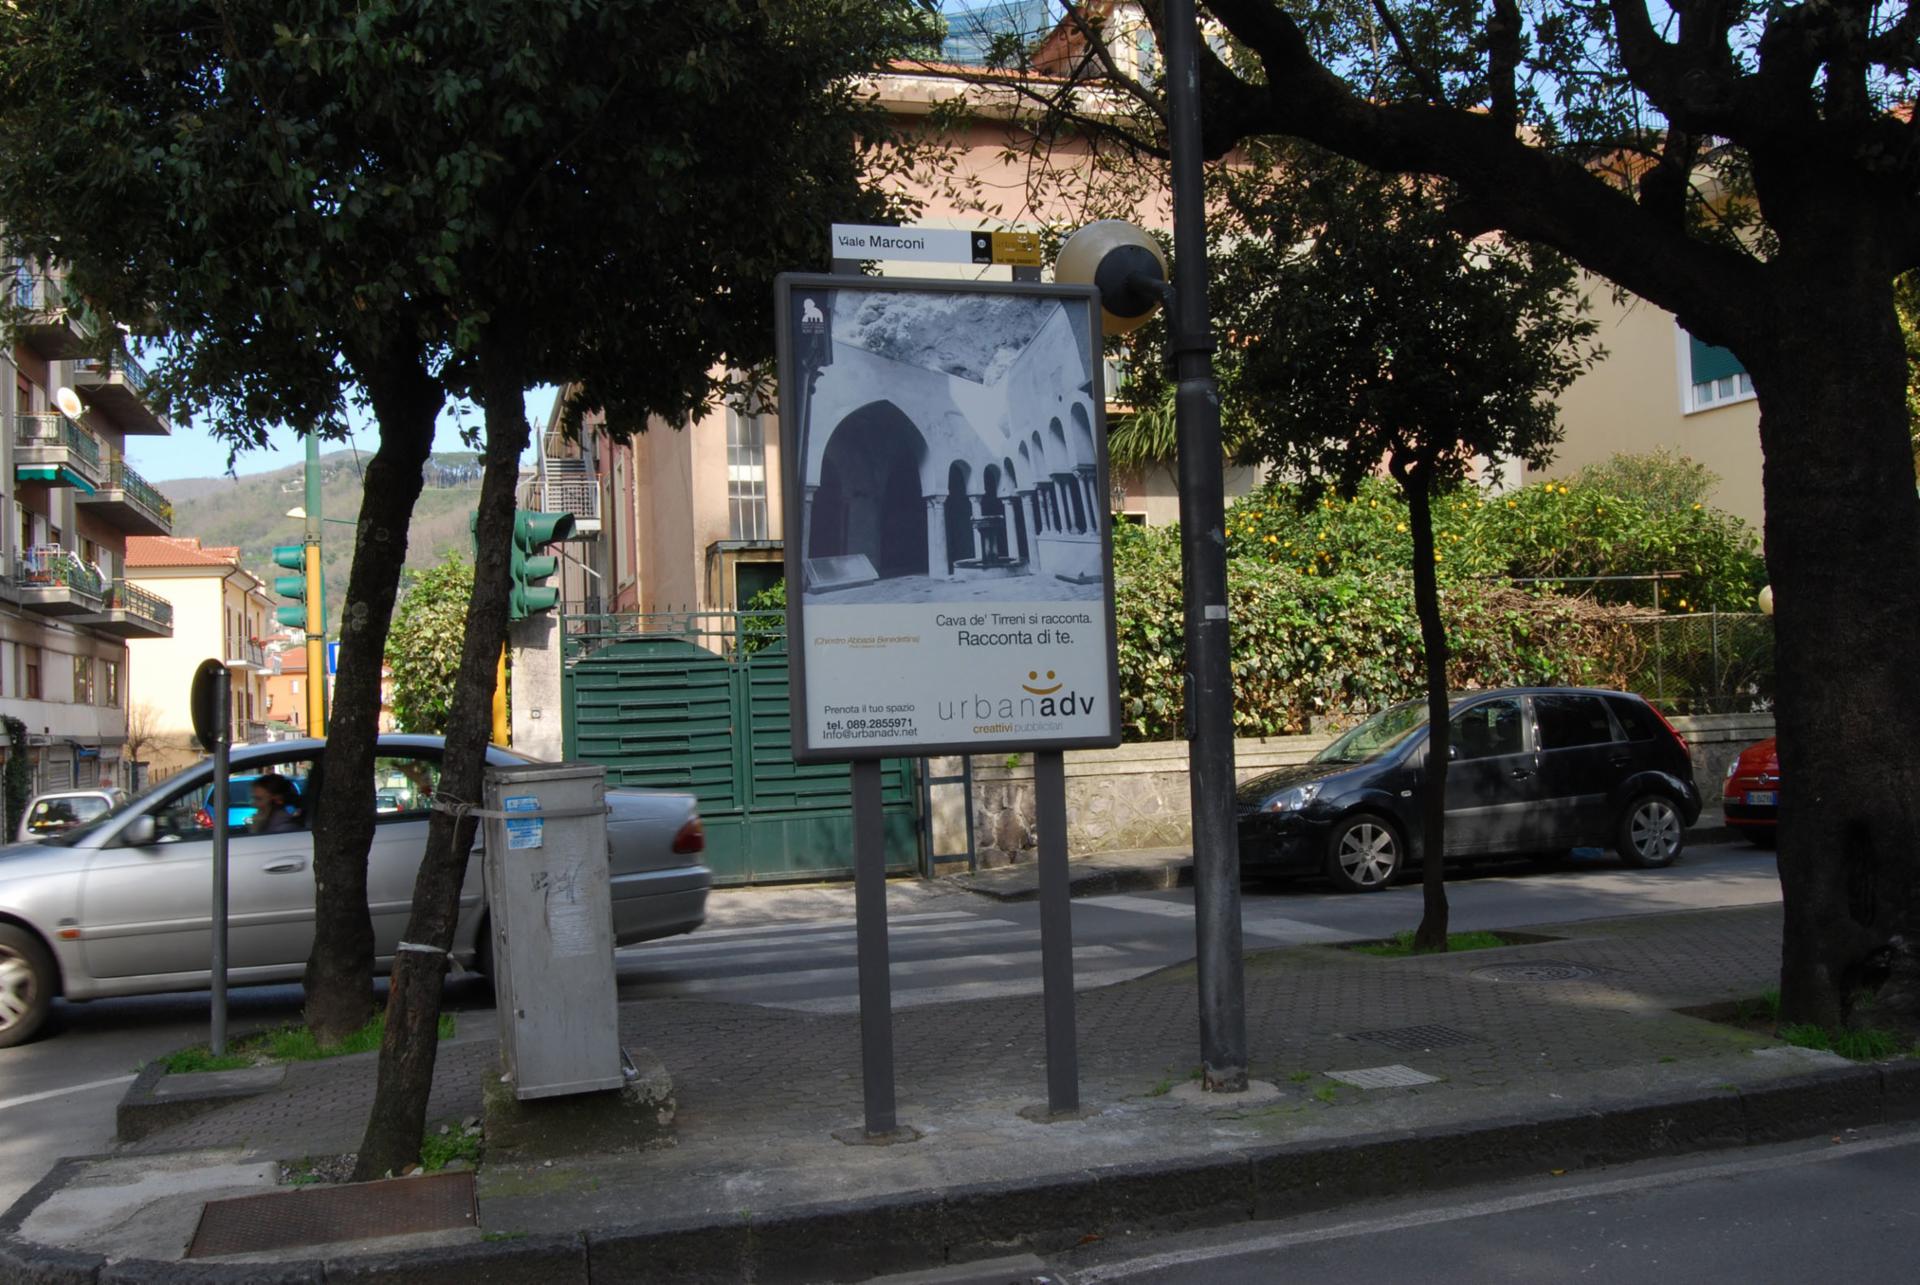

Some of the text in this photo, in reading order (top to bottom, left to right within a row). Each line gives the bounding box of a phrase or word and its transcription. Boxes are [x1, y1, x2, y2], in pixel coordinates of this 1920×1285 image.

[838, 235, 925, 249] Viale Marconi
[935, 612, 1093, 627] Cava de' Tirreni si racconta.
[957, 629, 1075, 646] Racconta di te.
[823, 703, 915, 714] Prenota il tuo spazio
[937, 690, 1095, 721] urbanadv
[826, 717, 912, 730] tel. 089.2855971
[972, 722, 1013, 734] creattivi
